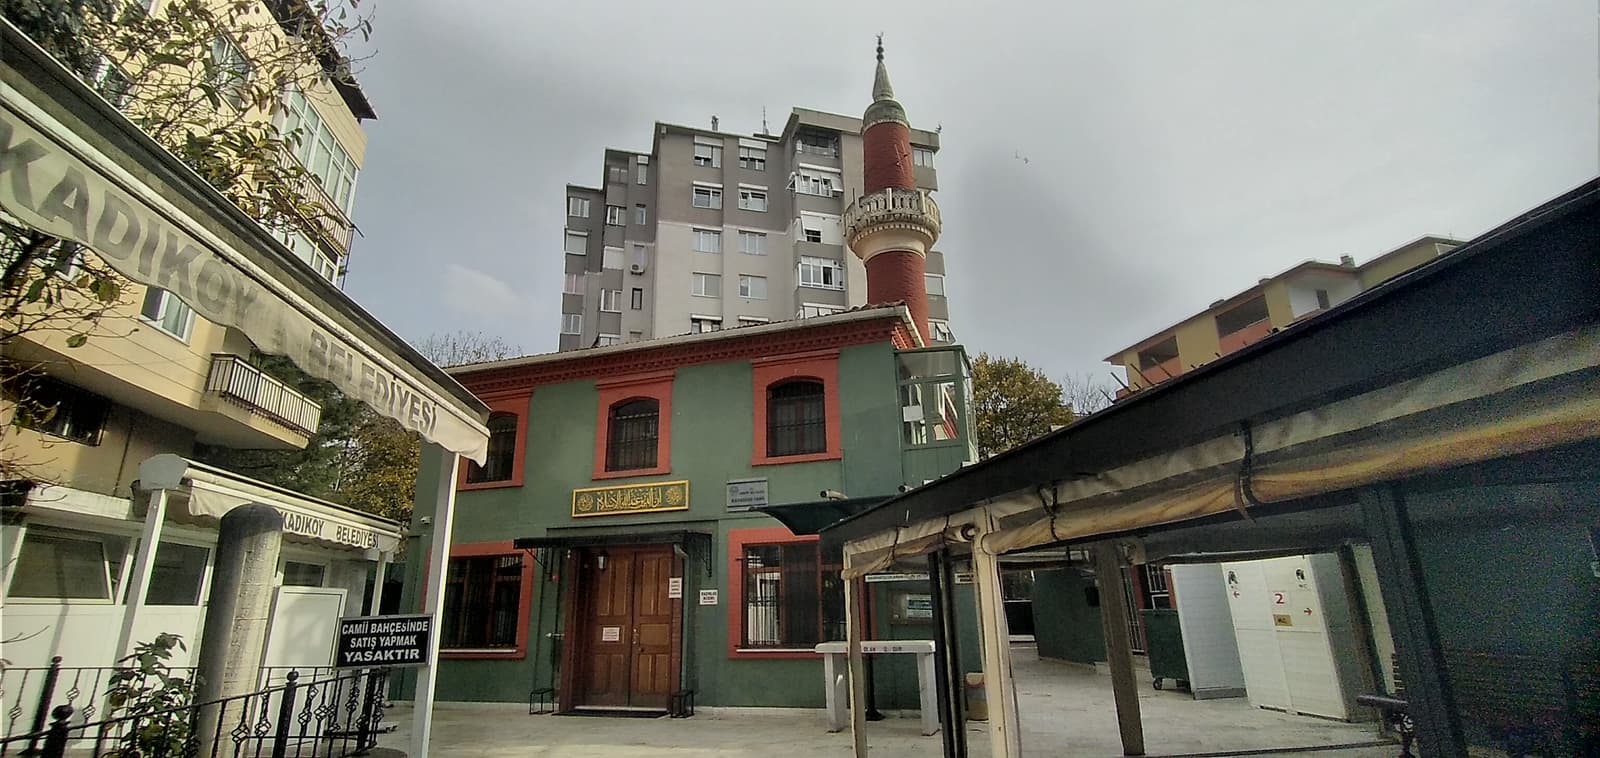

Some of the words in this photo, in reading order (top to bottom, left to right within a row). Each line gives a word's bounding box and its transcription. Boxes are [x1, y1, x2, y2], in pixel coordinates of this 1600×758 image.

[308, 328, 438, 437] BELEDİYESİ
[1274, 593, 1286, 605] 2
[342, 621, 369, 635] CAMİİ
[370, 619, 429, 635] BAHÇESİNDE
[350, 636, 377, 650] SATIŞ
[379, 635, 417, 647] YAPMAK
[345, 648, 420, 663] YASAKTIR
